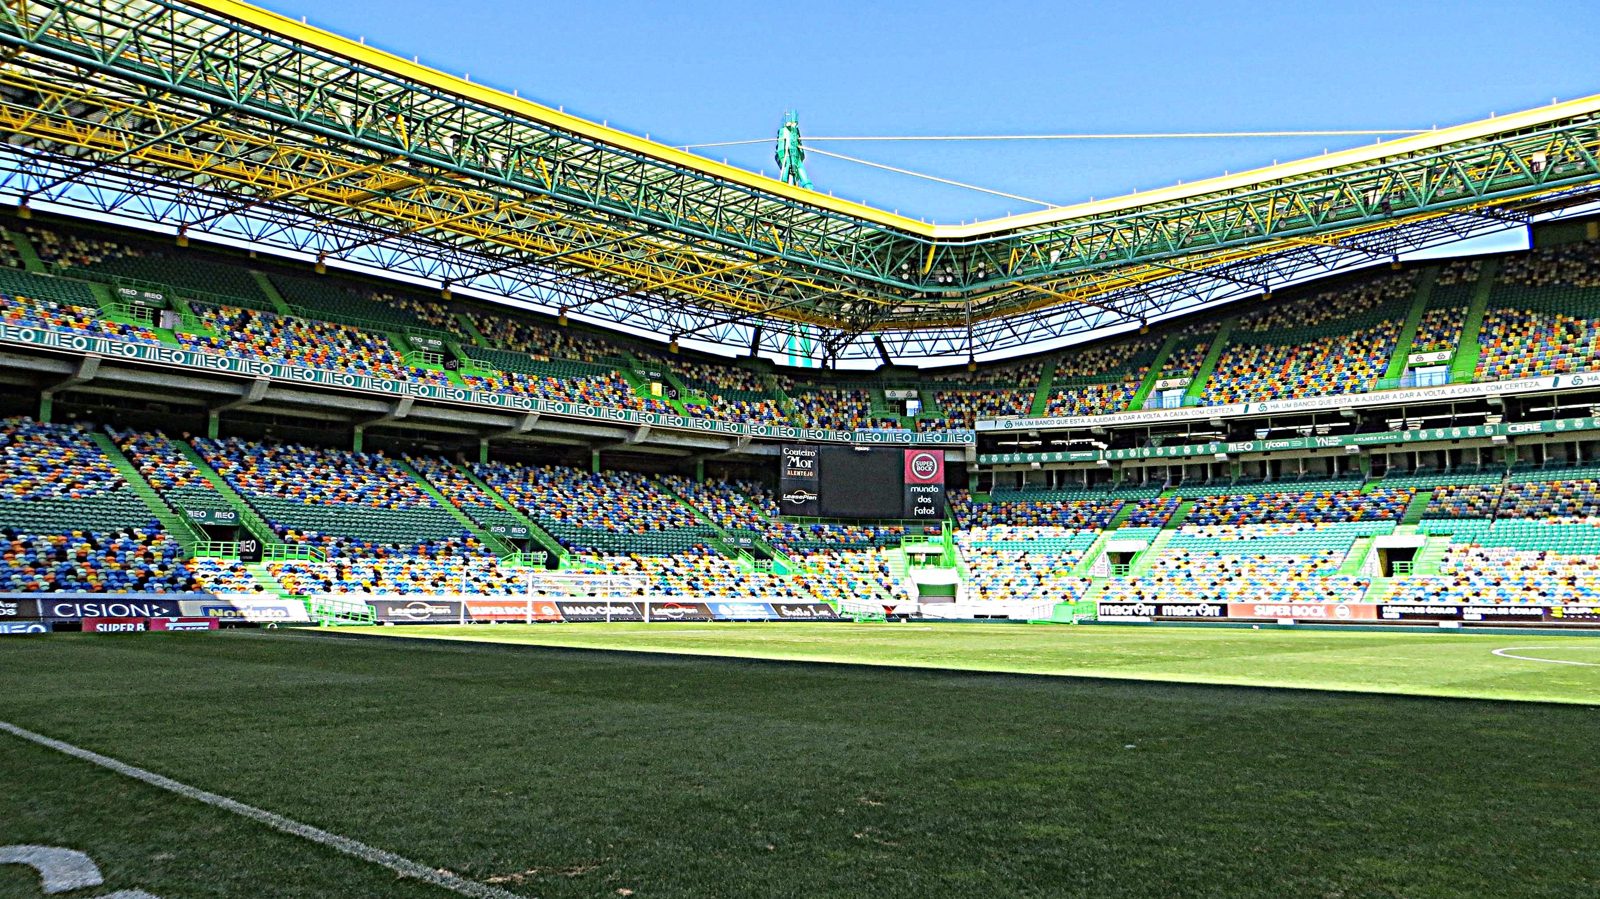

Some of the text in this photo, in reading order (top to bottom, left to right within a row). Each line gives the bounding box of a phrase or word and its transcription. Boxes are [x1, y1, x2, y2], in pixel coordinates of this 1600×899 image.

[43, 331, 87, 350] MEO
[95, 339, 137, 358] MEO
[146, 346, 185, 364] MEO
[193, 353, 230, 371] MEO
[238, 359, 273, 377] MEO
[280, 366, 316, 382] MEO
[322, 371, 355, 387] MEO
[361, 376, 393, 392] MEO
[399, 381, 430, 397] MEO
[435, 386, 465, 401] MEO
[471, 391, 500, 406] MEO
[505, 396, 532, 411] MEO
[538, 400, 565, 414] MEO
[570, 403, 596, 417] MEO
[601, 407, 626, 421] MEO
[630, 410, 655, 424] MEO
[660, 413, 684, 427] MEO
[688, 416, 711, 430] MEO
[716, 420, 739, 433] MEO
[743, 423, 766, 436] MEO
[771, 426, 795, 438] MEO
[800, 428, 824, 440] MEO
[828, 430, 852, 441] MEO
[856, 431, 881, 442] MEO
[886, 432, 911, 443] MEO
[916, 432, 942, 443] MEO
[947, 432, 973, 443] MEO
[1361, 394, 1390, 402] AJUDAR
[1508, 422, 1542, 433] CBRE
[1228, 442, 1254, 452] MEO
[787, 455, 814, 469] Mor
[910, 485, 939, 493] mundo
[917, 495, 932, 504] dos
[54, 603, 150, 617] CISION
